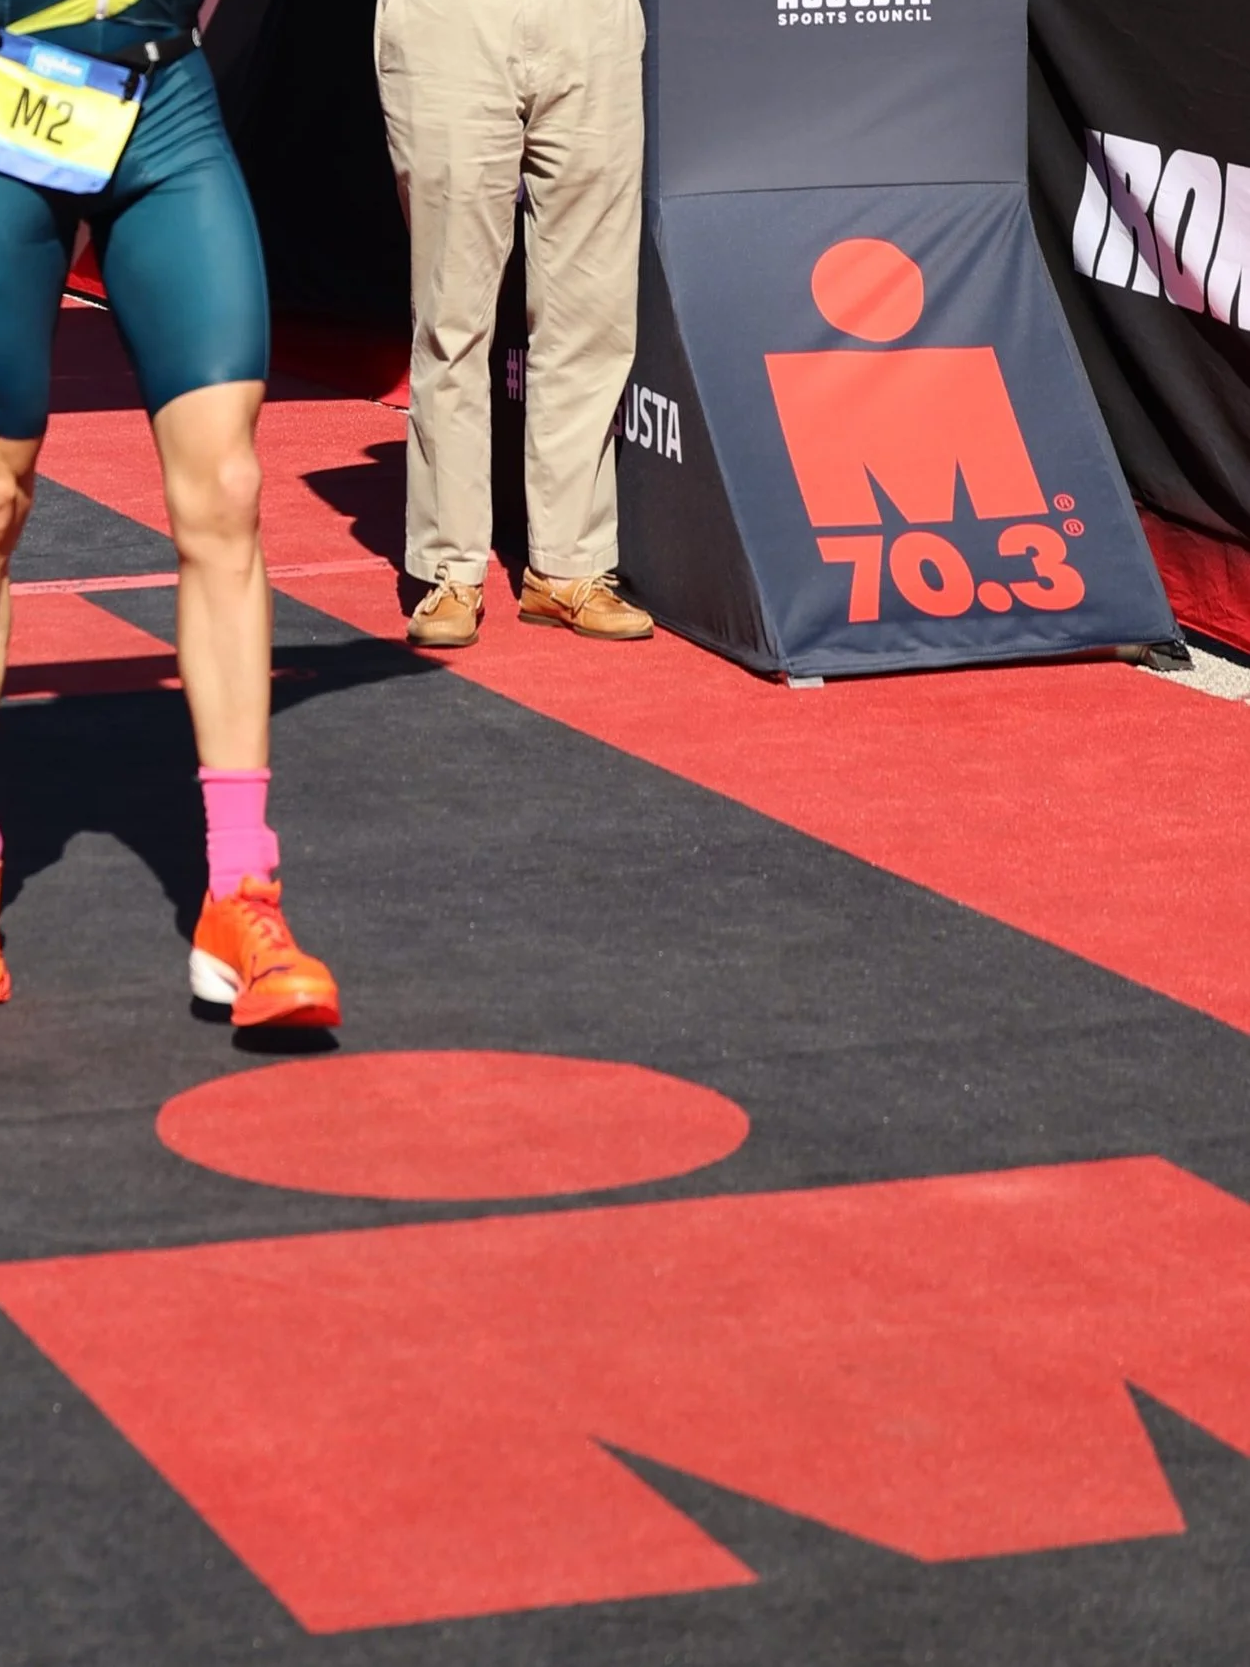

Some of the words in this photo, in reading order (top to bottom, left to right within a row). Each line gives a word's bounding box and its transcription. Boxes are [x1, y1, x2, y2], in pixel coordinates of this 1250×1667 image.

[777, 11, 848, 26] SPORTS
[854, 9, 932, 24] COUNCIL
[10, 87, 74, 146] M2
[815, 522, 1086, 623] 70.3
